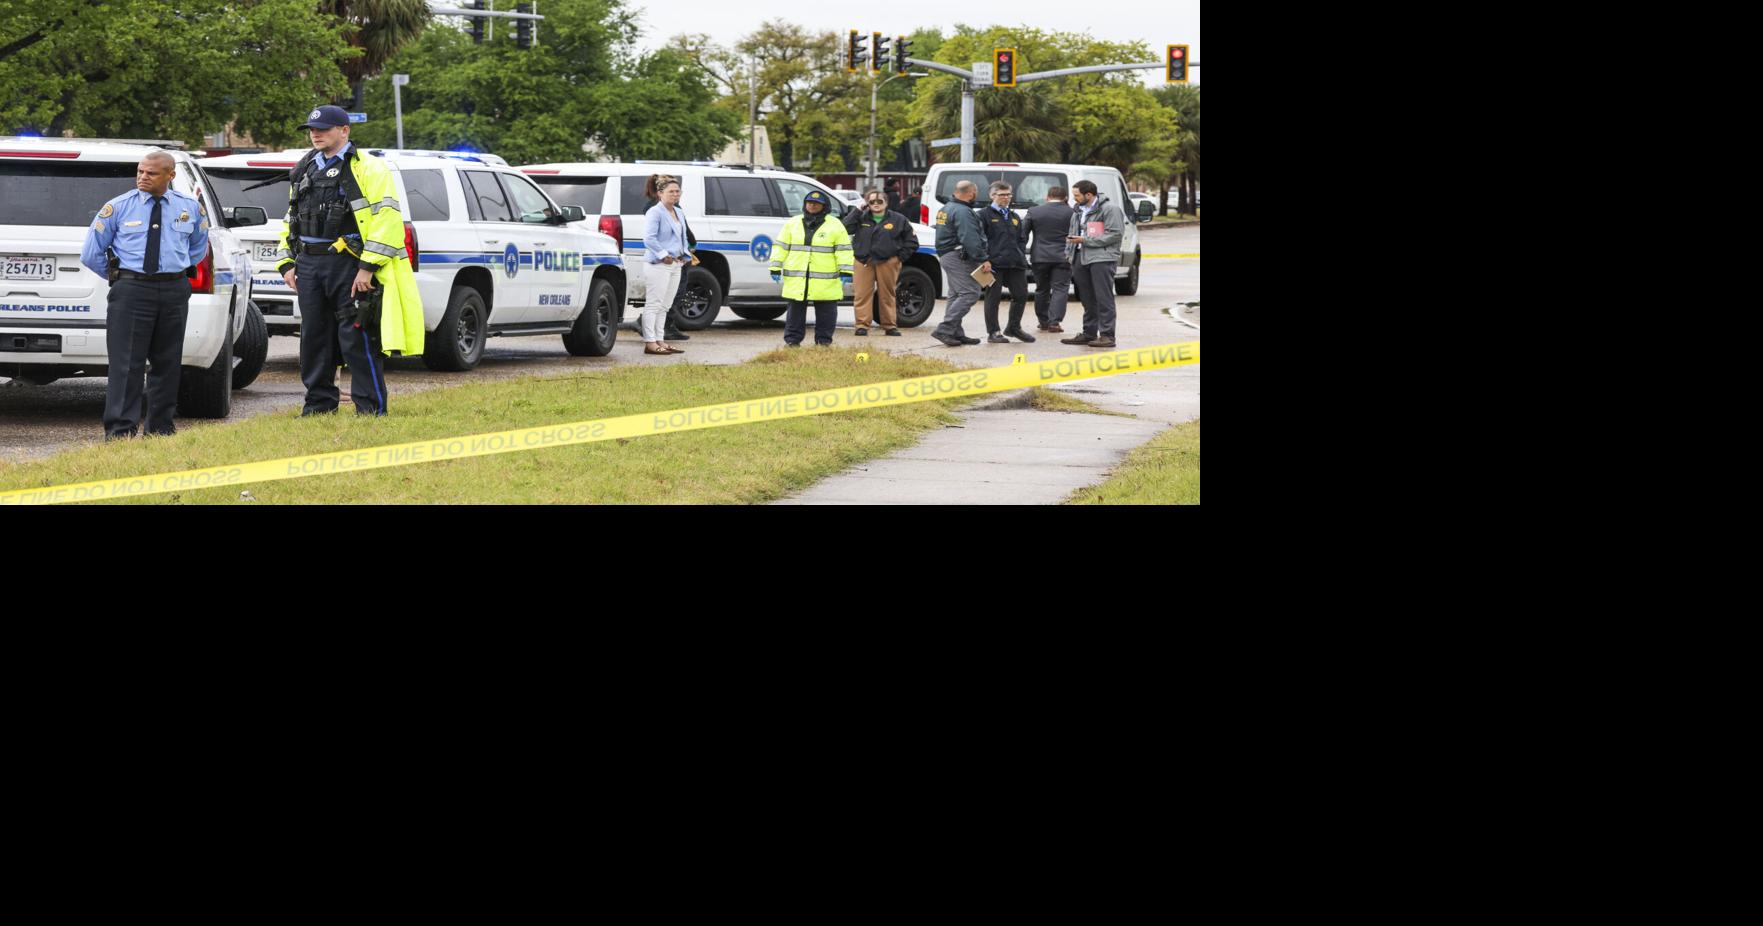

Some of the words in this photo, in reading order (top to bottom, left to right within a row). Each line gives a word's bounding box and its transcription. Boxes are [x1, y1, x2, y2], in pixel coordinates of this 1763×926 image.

[534, 250, 580, 272] POLICE
[6, 263, 52, 275] 254713
[539, 294, 549, 305] NEW
[550, 294, 571, 305] ORLEANS
[0, 304, 45, 312] RLEANS
